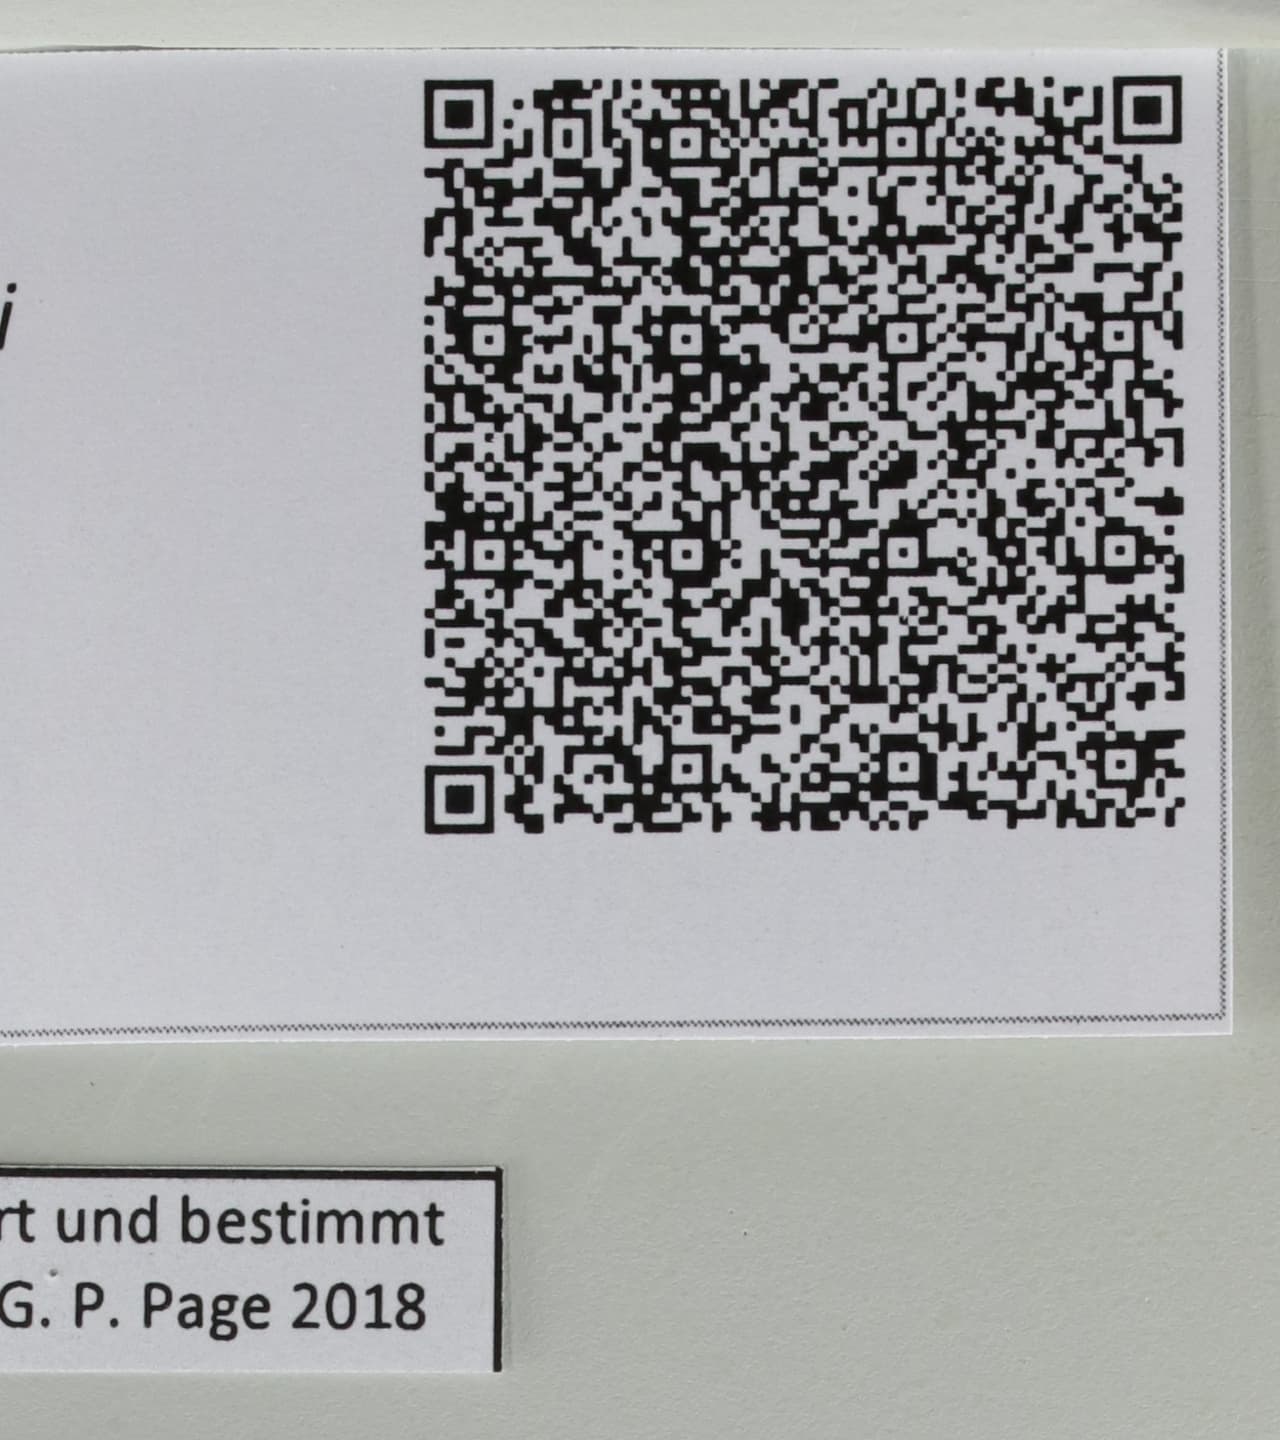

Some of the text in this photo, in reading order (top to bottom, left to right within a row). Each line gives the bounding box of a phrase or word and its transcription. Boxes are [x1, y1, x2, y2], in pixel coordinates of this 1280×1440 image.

[56, 1194, 158, 1245] und
[181, 1194, 445, 1247] bestimmt
[74, 1281, 119, 1329] P.
[143, 1281, 271, 1342] Page
[291, 1281, 426, 1331] 2018
